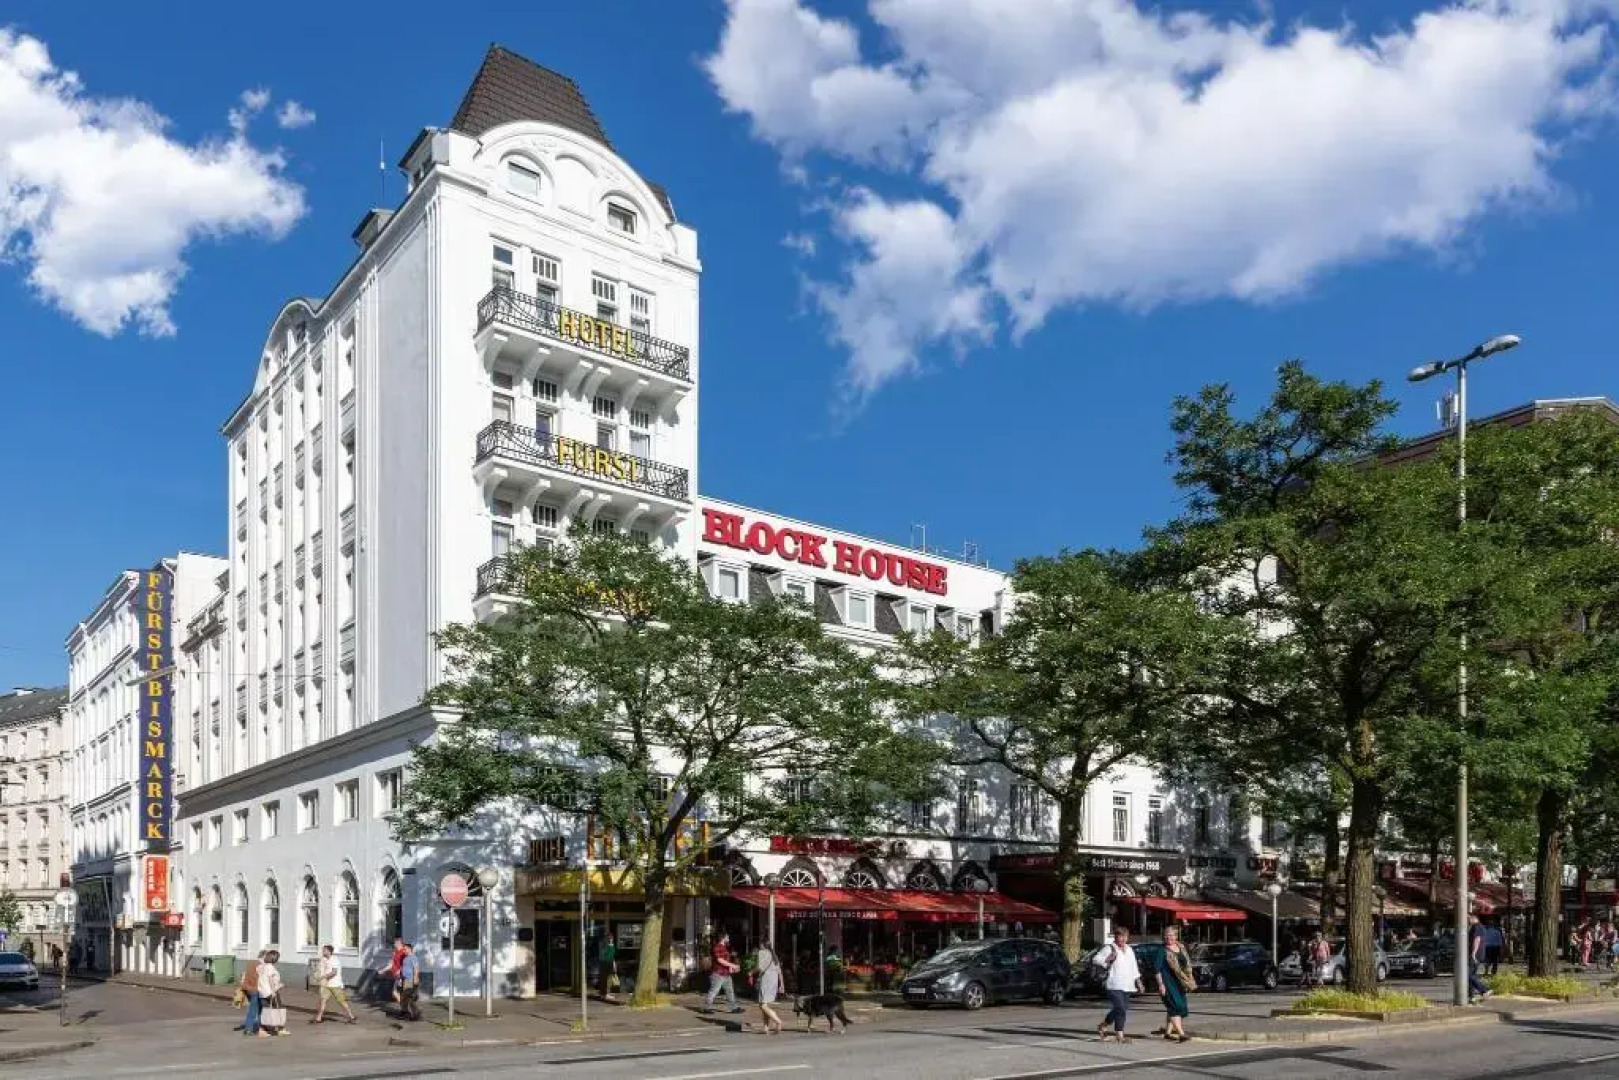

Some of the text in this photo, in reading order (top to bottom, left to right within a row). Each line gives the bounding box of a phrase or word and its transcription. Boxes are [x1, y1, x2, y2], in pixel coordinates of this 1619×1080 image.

[559, 307, 638, 359] HOTEL
[702, 508, 947, 596] BLOCK HOUSE
